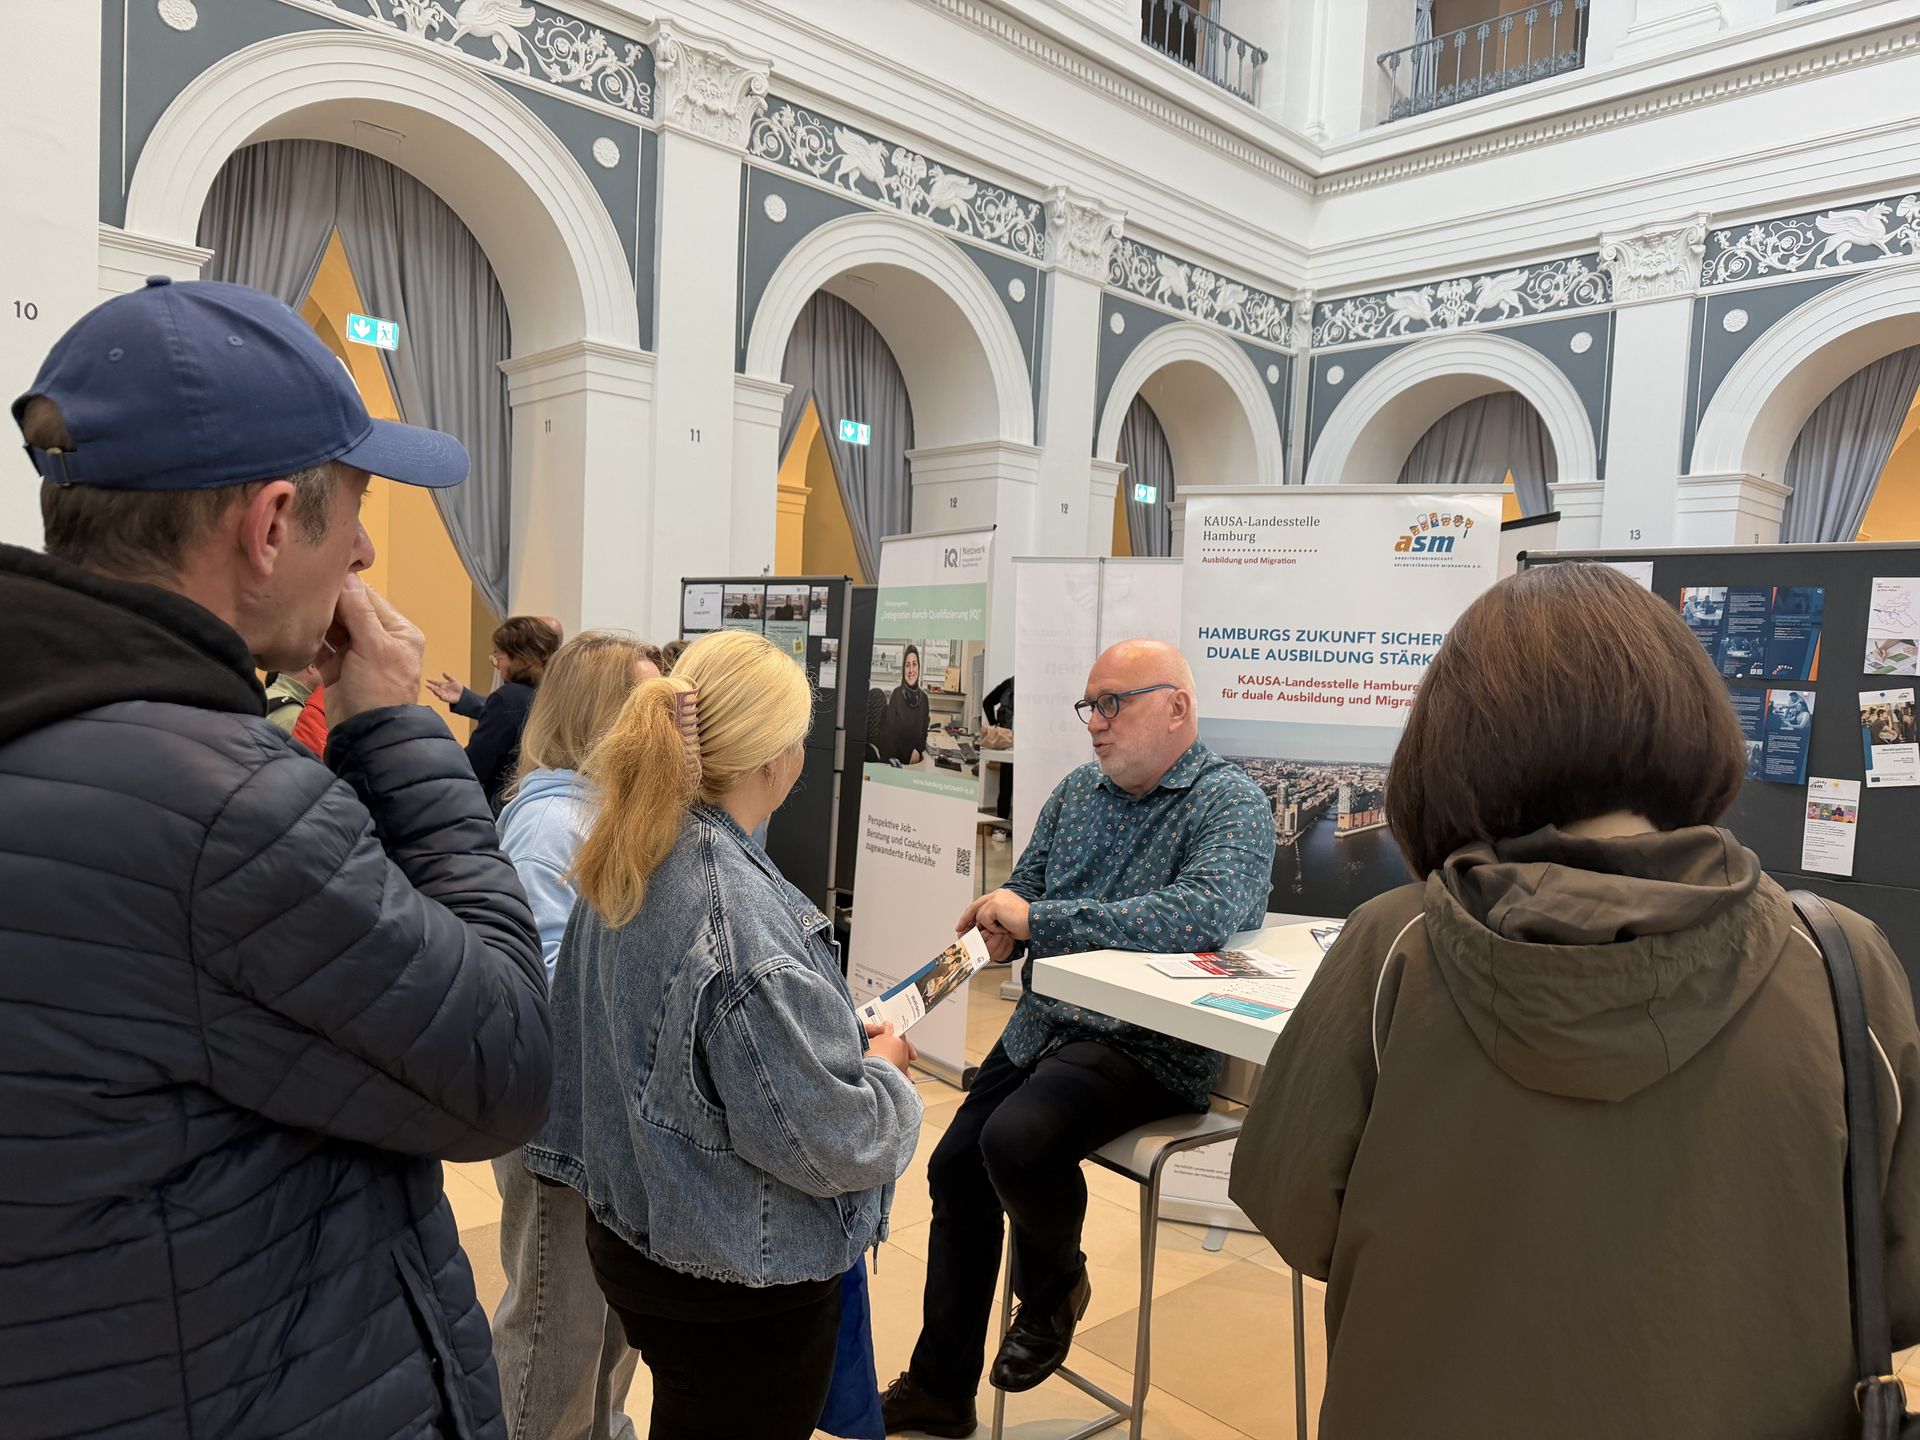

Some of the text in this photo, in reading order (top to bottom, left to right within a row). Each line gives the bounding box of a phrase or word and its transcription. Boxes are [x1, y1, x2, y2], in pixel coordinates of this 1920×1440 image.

[14, 300, 38, 320] 10
[545, 419, 551, 433] 11
[690, 428, 700, 443] 11
[1061, 503, 1069, 514] 12
[1204, 516, 1320, 527] KAUSA-Landesstelle
[1203, 531, 1256, 543] Hamburg
[1630, 530, 1641, 541] 13
[1394, 535, 1455, 552] asm
[1202, 556, 1243, 565] Ausbildung
[1260, 557, 1296, 565] Migration
[699, 597, 705, 607] 9
[1198, 627, 1290, 641] HAMBURGS
[1296, 630, 1376, 644] ZUKUNFT
[1207, 646, 1434, 666] DUALE AUSBILDUNG STÄRK
[1238, 675, 1359, 689] KAUSA-Landesstelle
[1222, 688, 1413, 709] für duale Ausbildung und Migra
[868, 814, 900, 831] Perspektive
[901, 822, 911, 833] Job
[867, 828, 942, 855] Beratung und Coaching für
[865, 842, 936, 867] zugewanderte Fachkräfte
